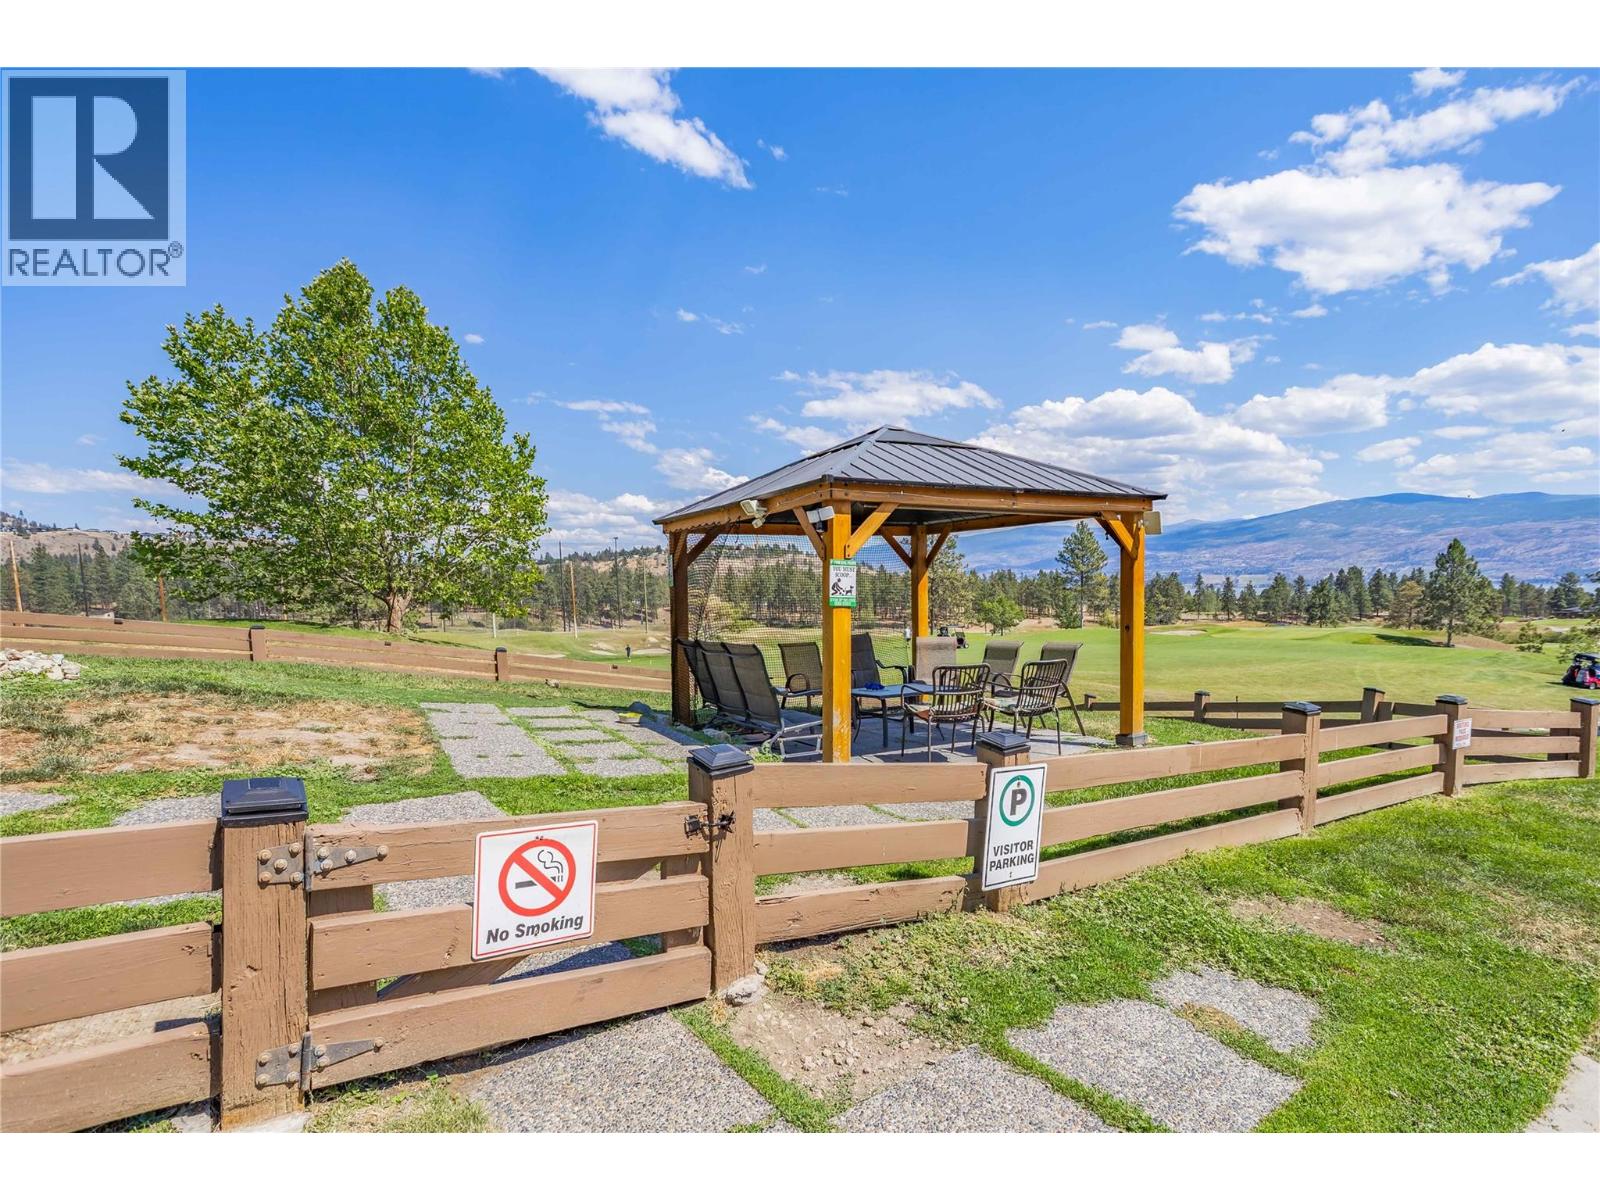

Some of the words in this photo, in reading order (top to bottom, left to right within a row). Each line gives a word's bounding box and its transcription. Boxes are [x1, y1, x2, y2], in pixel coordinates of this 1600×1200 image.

[1009, 788, 1027, 816] P
[993, 840, 1034, 857] VISITOR
[989, 853, 1034, 872] PARKING
[486, 928, 509, 944] No
[514, 915, 584, 938] Smoking
